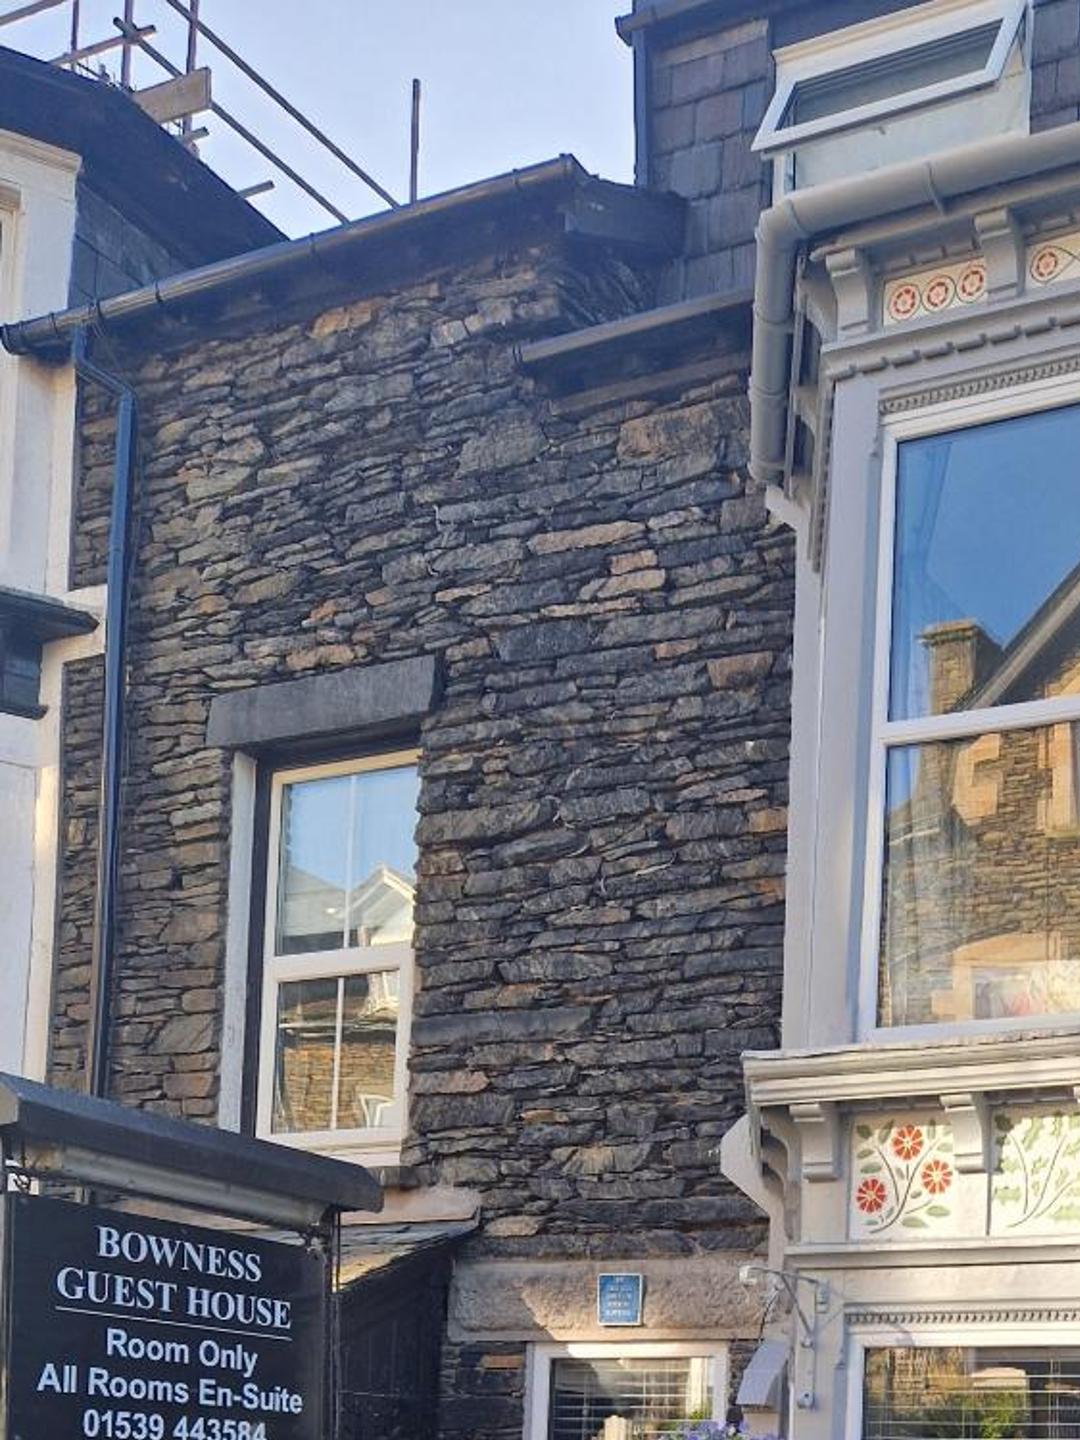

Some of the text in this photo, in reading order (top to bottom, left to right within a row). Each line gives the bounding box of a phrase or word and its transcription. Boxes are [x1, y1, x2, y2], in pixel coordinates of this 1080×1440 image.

[97, 1225, 262, 1282] BOWNESS
[56, 1266, 292, 1329] GUEST HOUSE
[107, 1327, 258, 1378] Room Only
[36, 1362, 303, 1414] All Rooms En-Suite
[84, 1409, 164, 1440] 01539
